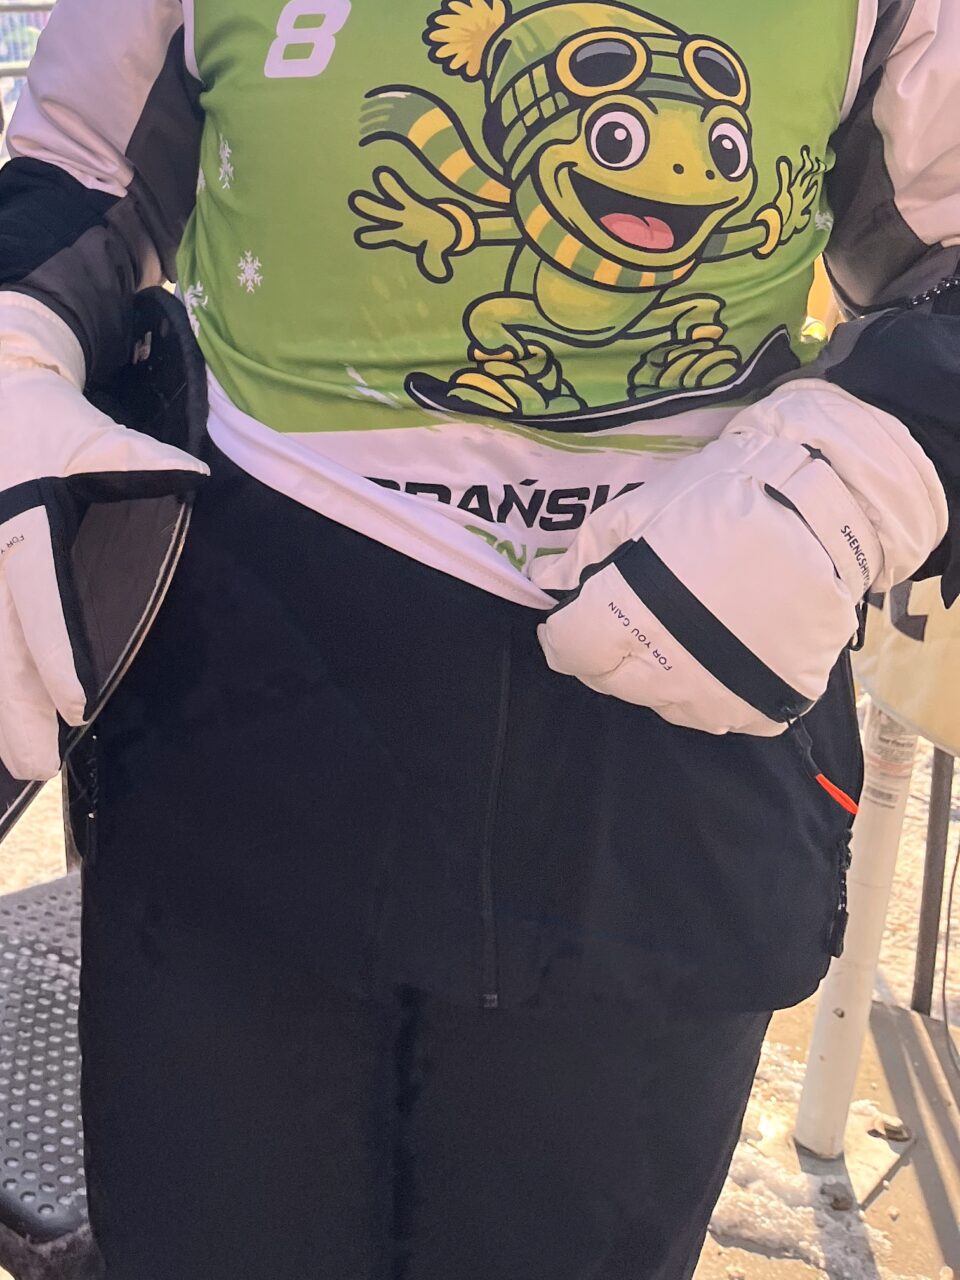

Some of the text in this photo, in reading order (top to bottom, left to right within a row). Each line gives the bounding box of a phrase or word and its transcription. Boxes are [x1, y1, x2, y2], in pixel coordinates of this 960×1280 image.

[362, 477, 645, 531] AŃS
[630, 628, 651, 649] YOU
[652, 649, 673, 671] FOR
